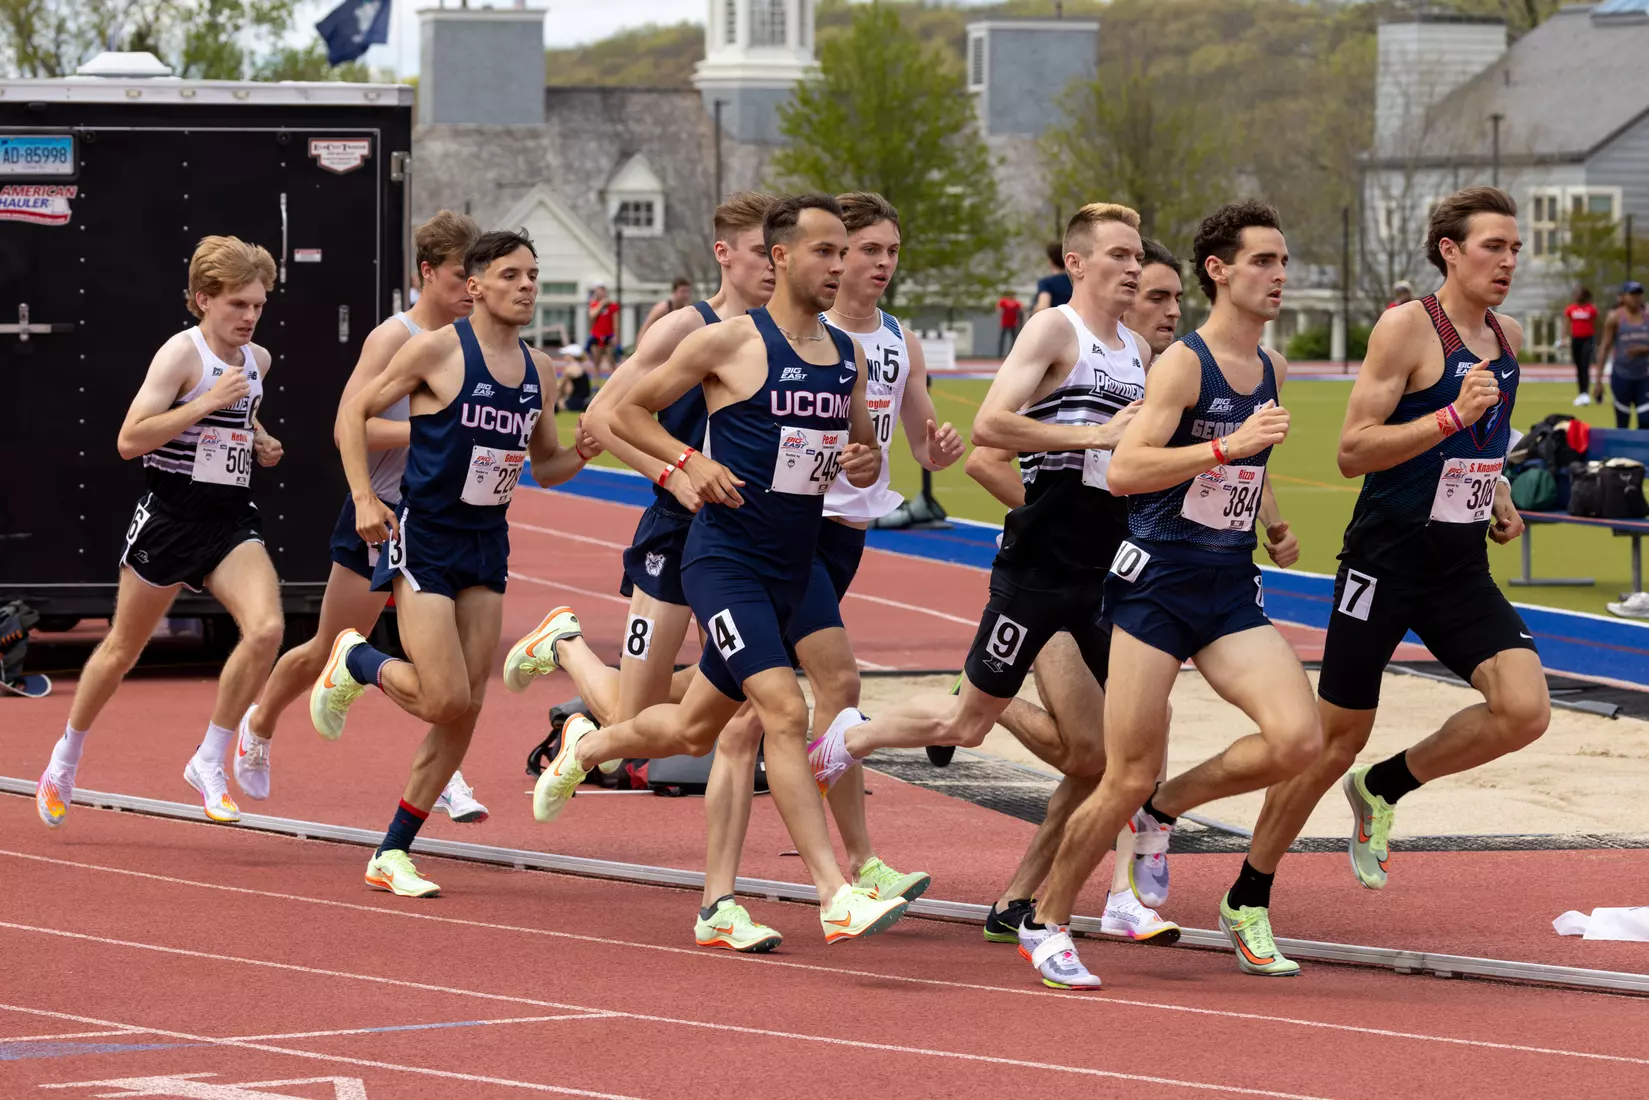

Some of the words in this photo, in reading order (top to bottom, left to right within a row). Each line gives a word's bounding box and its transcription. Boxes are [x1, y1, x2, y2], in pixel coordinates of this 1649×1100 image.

[0, 198, 49, 208] HAULER
[1, 186, 76, 197] AMERICAN
[882, 347, 900, 384] 5
[1457, 361, 1474, 369] BIG
[473, 388, 495, 396] EAST
[1089, 368, 1145, 400] PROVIDEN
[461, 403, 529, 435] UCON
[783, 441, 806, 449] EAST
[809, 451, 842, 482] 245
[1199, 473, 1224, 483] EAST
[1205, 470, 1222, 479] BIG
[1237, 469, 1256, 481] Rizzo
[1469, 462, 1475, 473] S.
[1223, 486, 1259, 517] 384
[1466, 477, 1498, 510] 308
[390, 531, 403, 566] 3
[1346, 574, 1370, 613] 7
[627, 618, 648, 656] 8
[715, 615, 737, 652] 4
[992, 622, 1020, 658] 9
